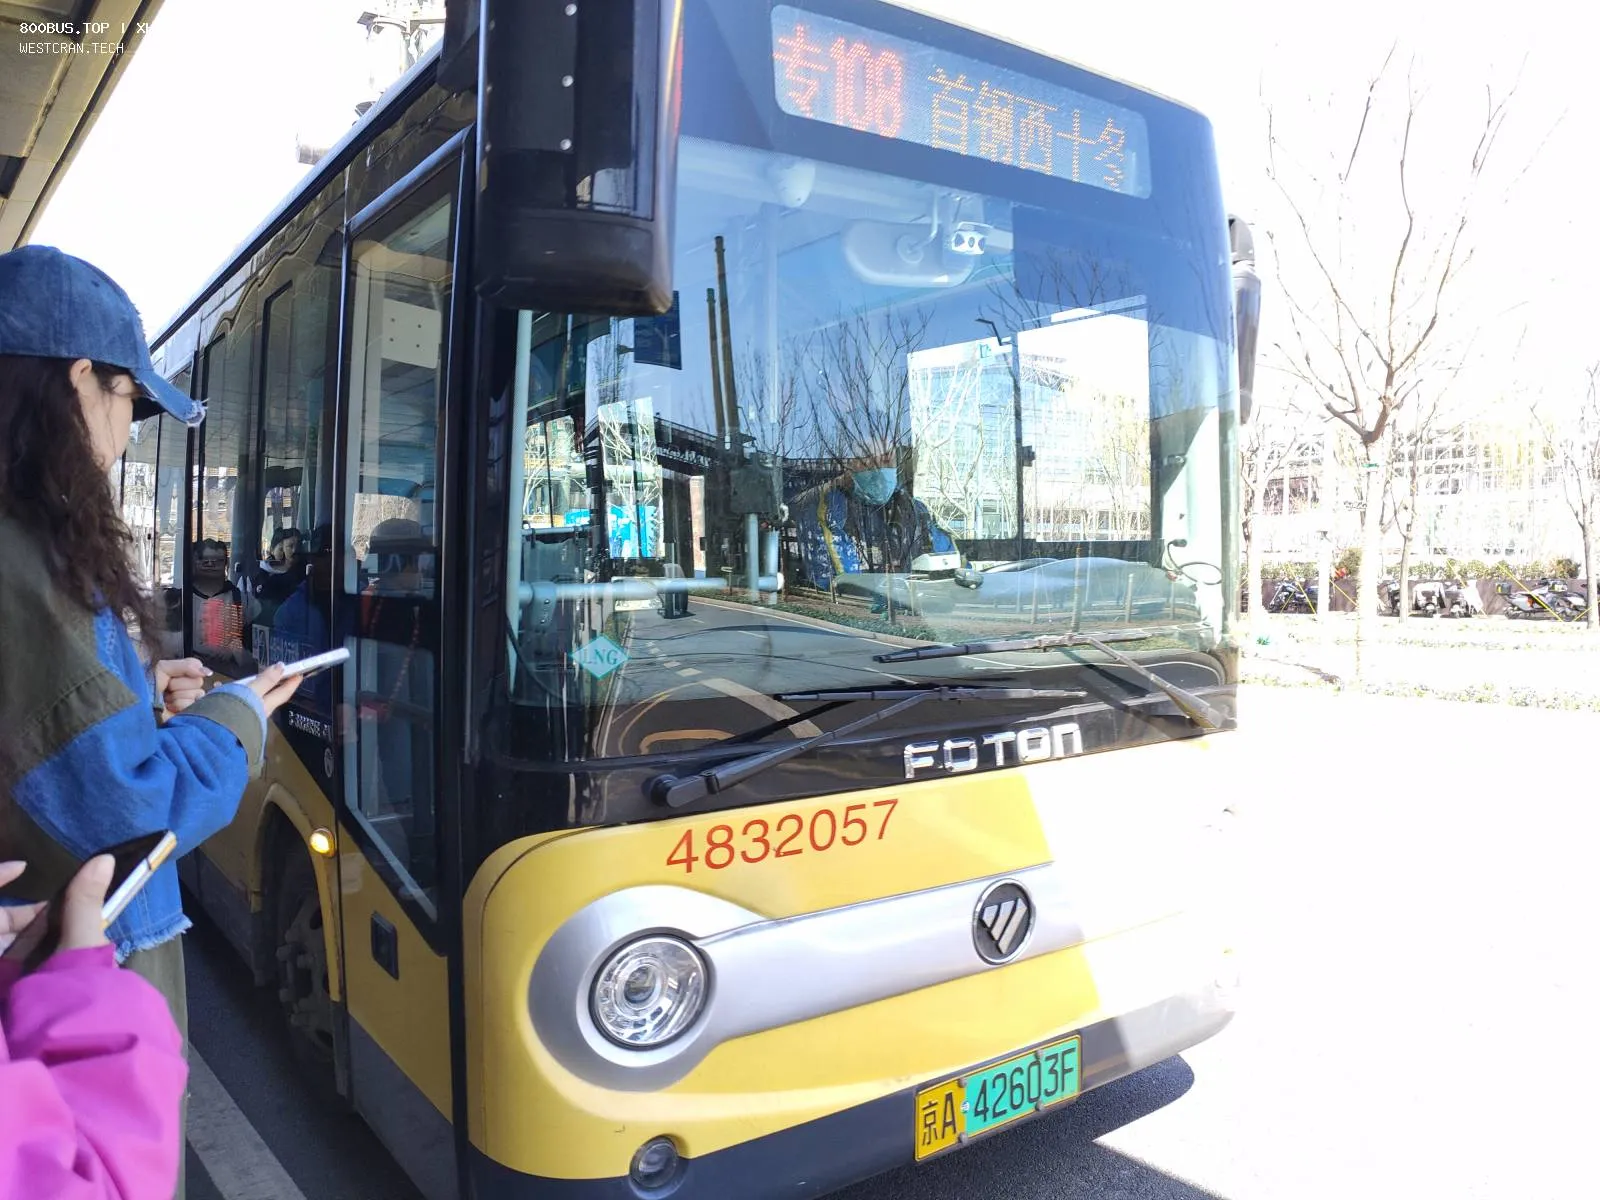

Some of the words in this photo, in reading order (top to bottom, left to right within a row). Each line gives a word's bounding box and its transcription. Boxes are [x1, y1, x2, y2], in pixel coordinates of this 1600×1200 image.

[582, 648, 618, 665] LNG
[904, 721, 1083, 780] FOTON
[665, 798, 899, 874] 4832057
[973, 1046, 1077, 1122] 42603F
